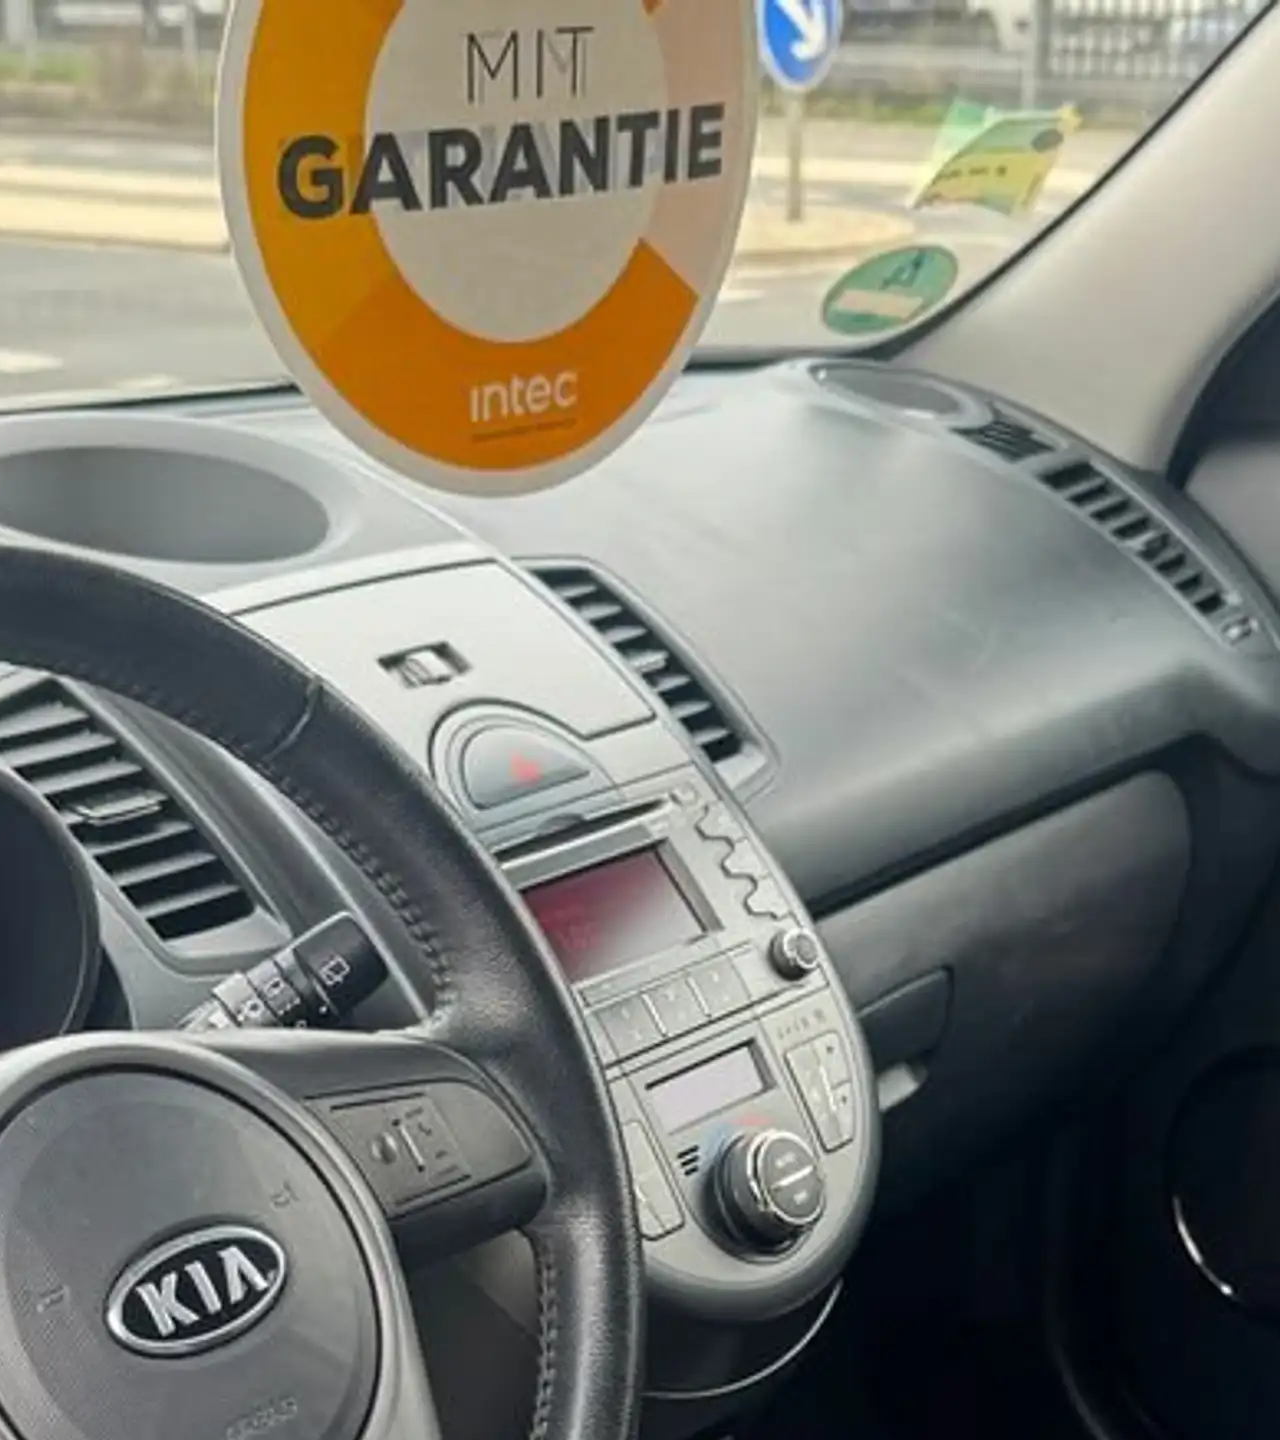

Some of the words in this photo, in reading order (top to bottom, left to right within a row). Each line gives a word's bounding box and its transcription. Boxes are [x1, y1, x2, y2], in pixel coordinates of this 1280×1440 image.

[465, 25, 595, 104] MIT
[277, 104, 725, 220] GARANTIE
[471, 371, 578, 422] intec
[136, 1246, 269, 1337] KIA
